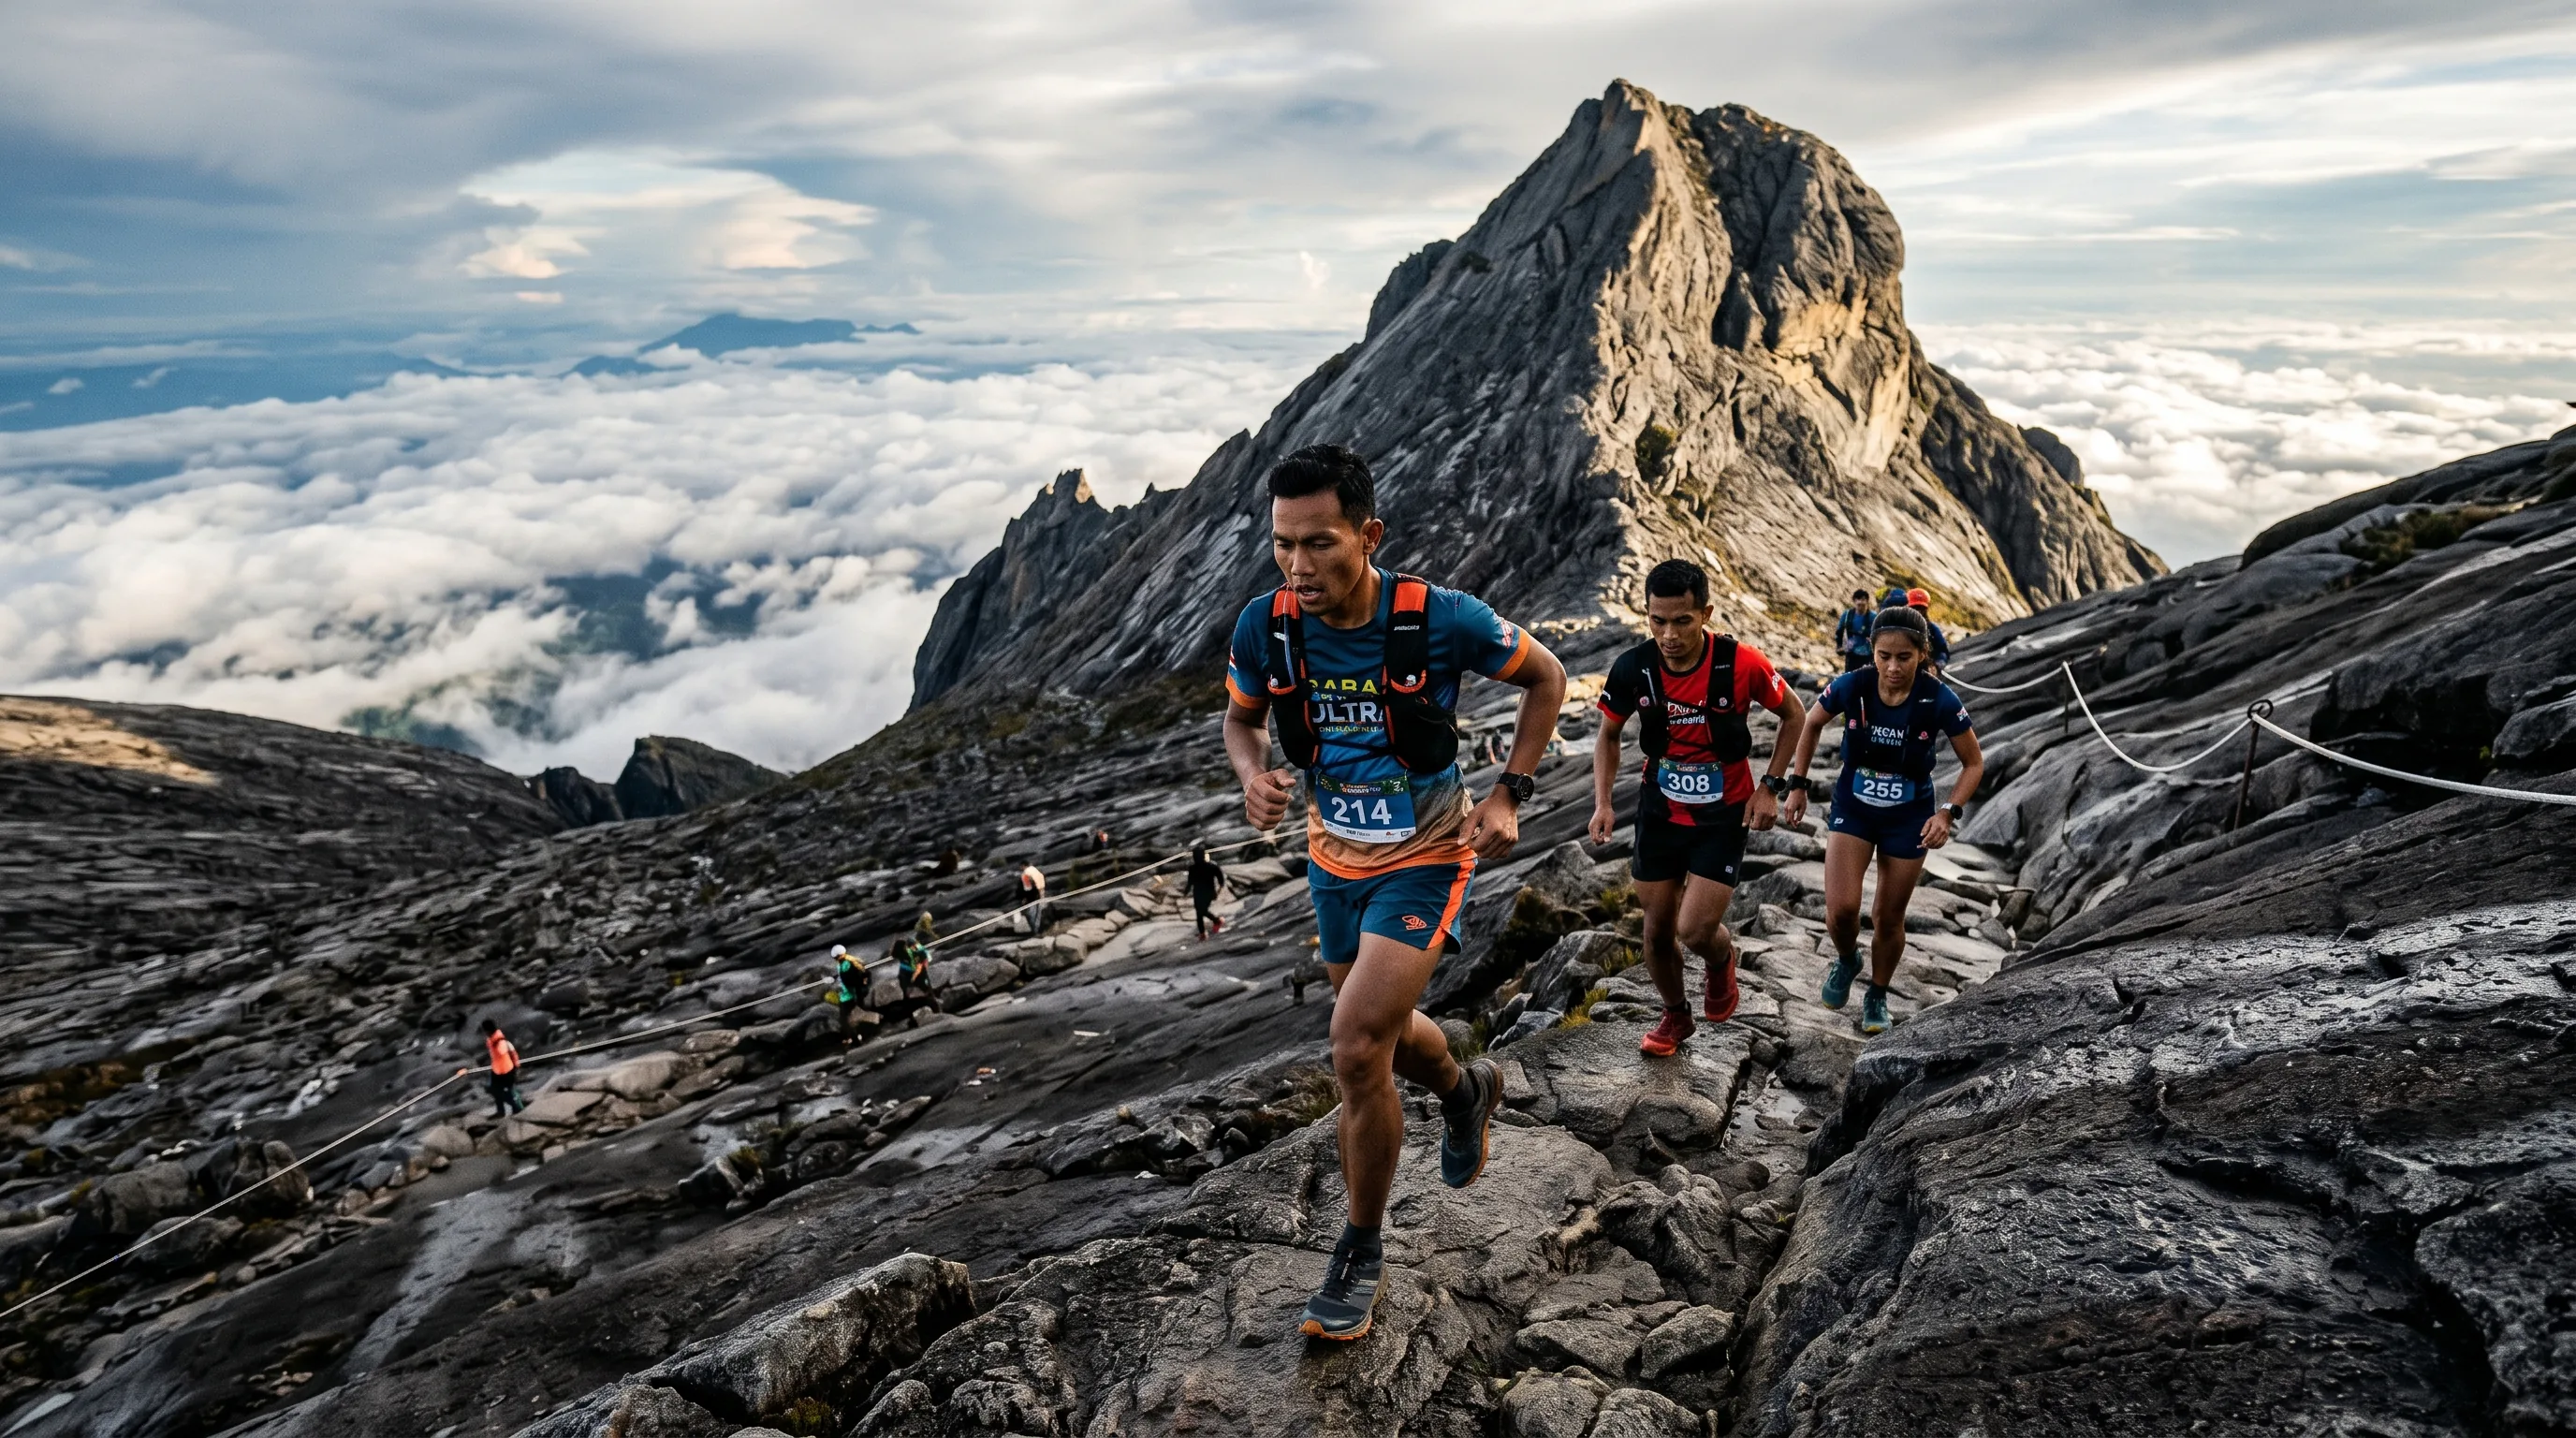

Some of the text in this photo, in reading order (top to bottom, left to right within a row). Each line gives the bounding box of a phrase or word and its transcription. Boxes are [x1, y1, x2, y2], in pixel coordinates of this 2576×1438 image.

[1667, 772, 1710, 793] 308
[1863, 779, 1903, 800] 255
[1331, 797, 1393, 825] 214
